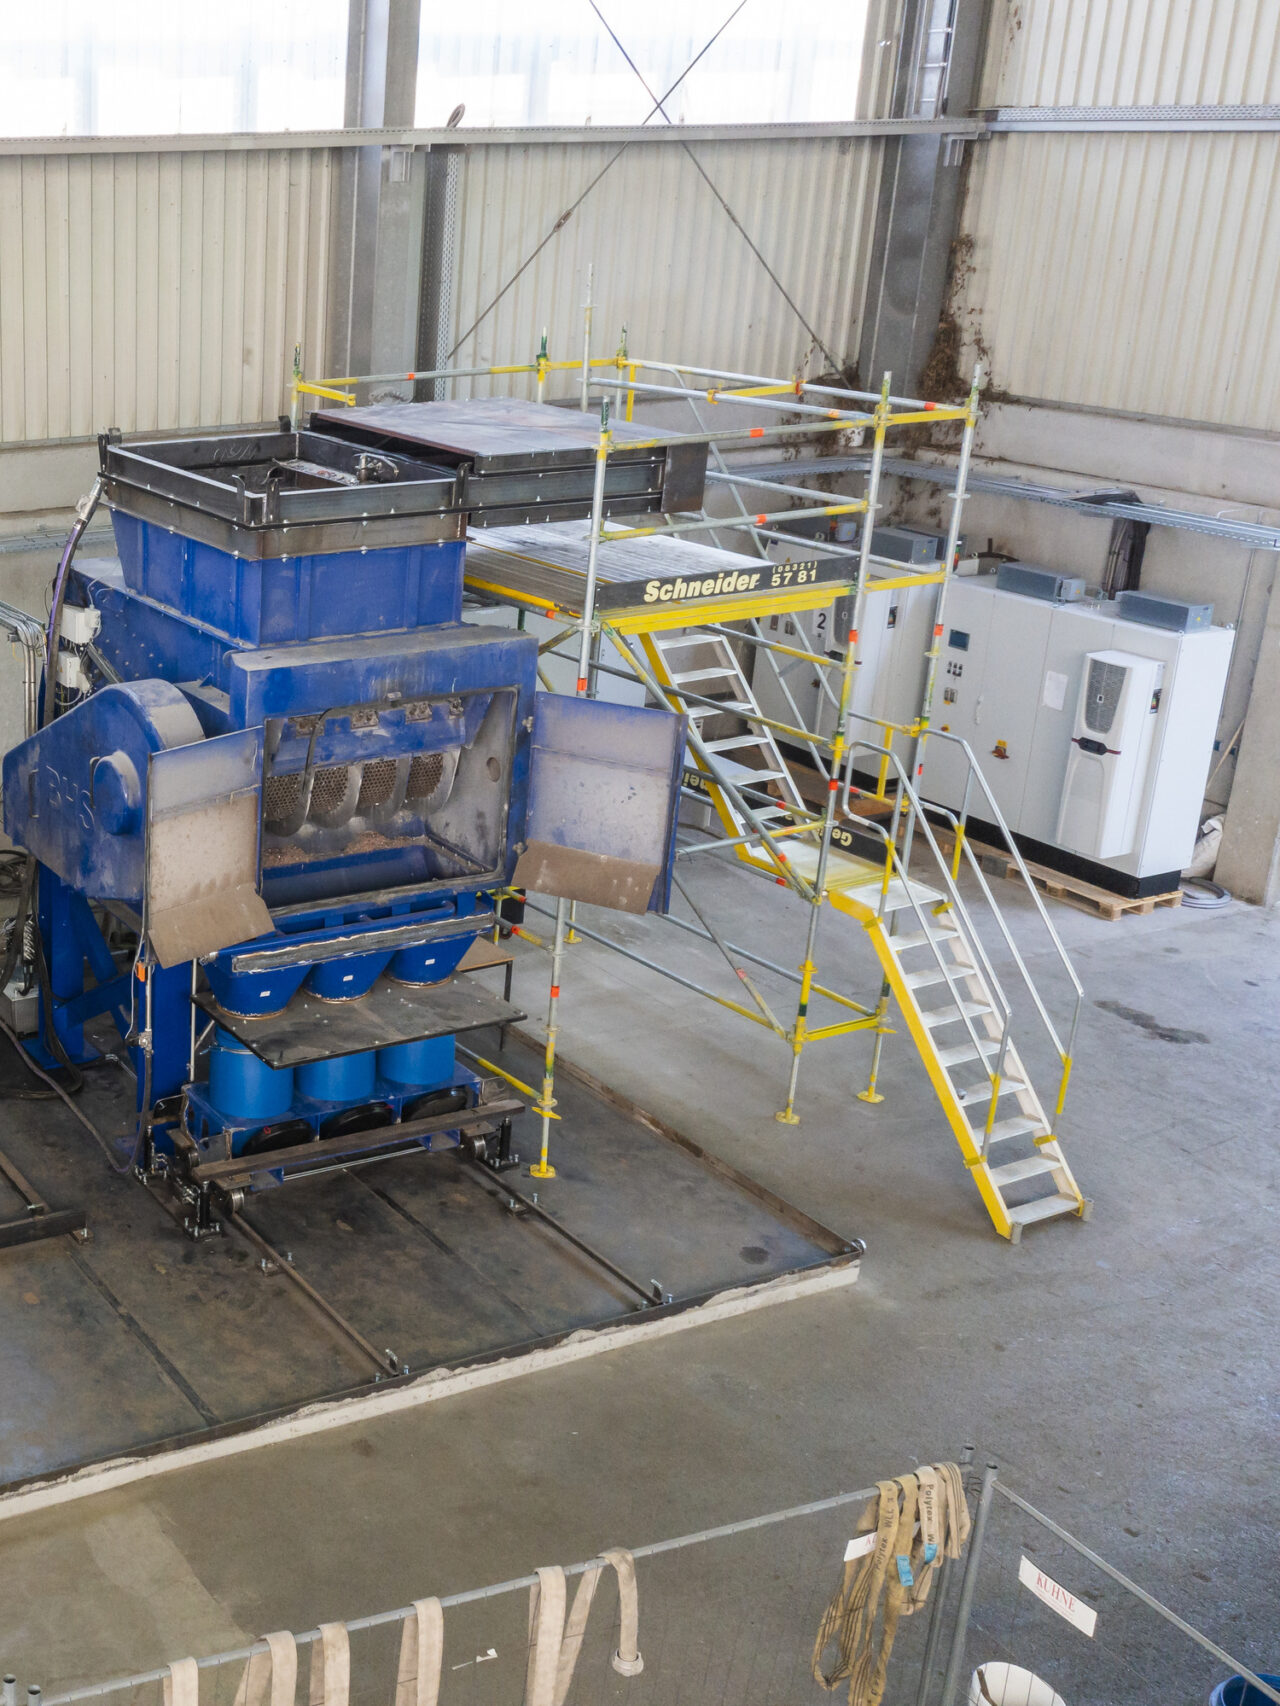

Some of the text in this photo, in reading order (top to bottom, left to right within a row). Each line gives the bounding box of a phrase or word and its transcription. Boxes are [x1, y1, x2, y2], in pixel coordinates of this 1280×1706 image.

[644, 569, 817, 603] Schneider 57 81
[816, 612, 827, 630] 2
[924, 1484, 934, 1521] Polytex
